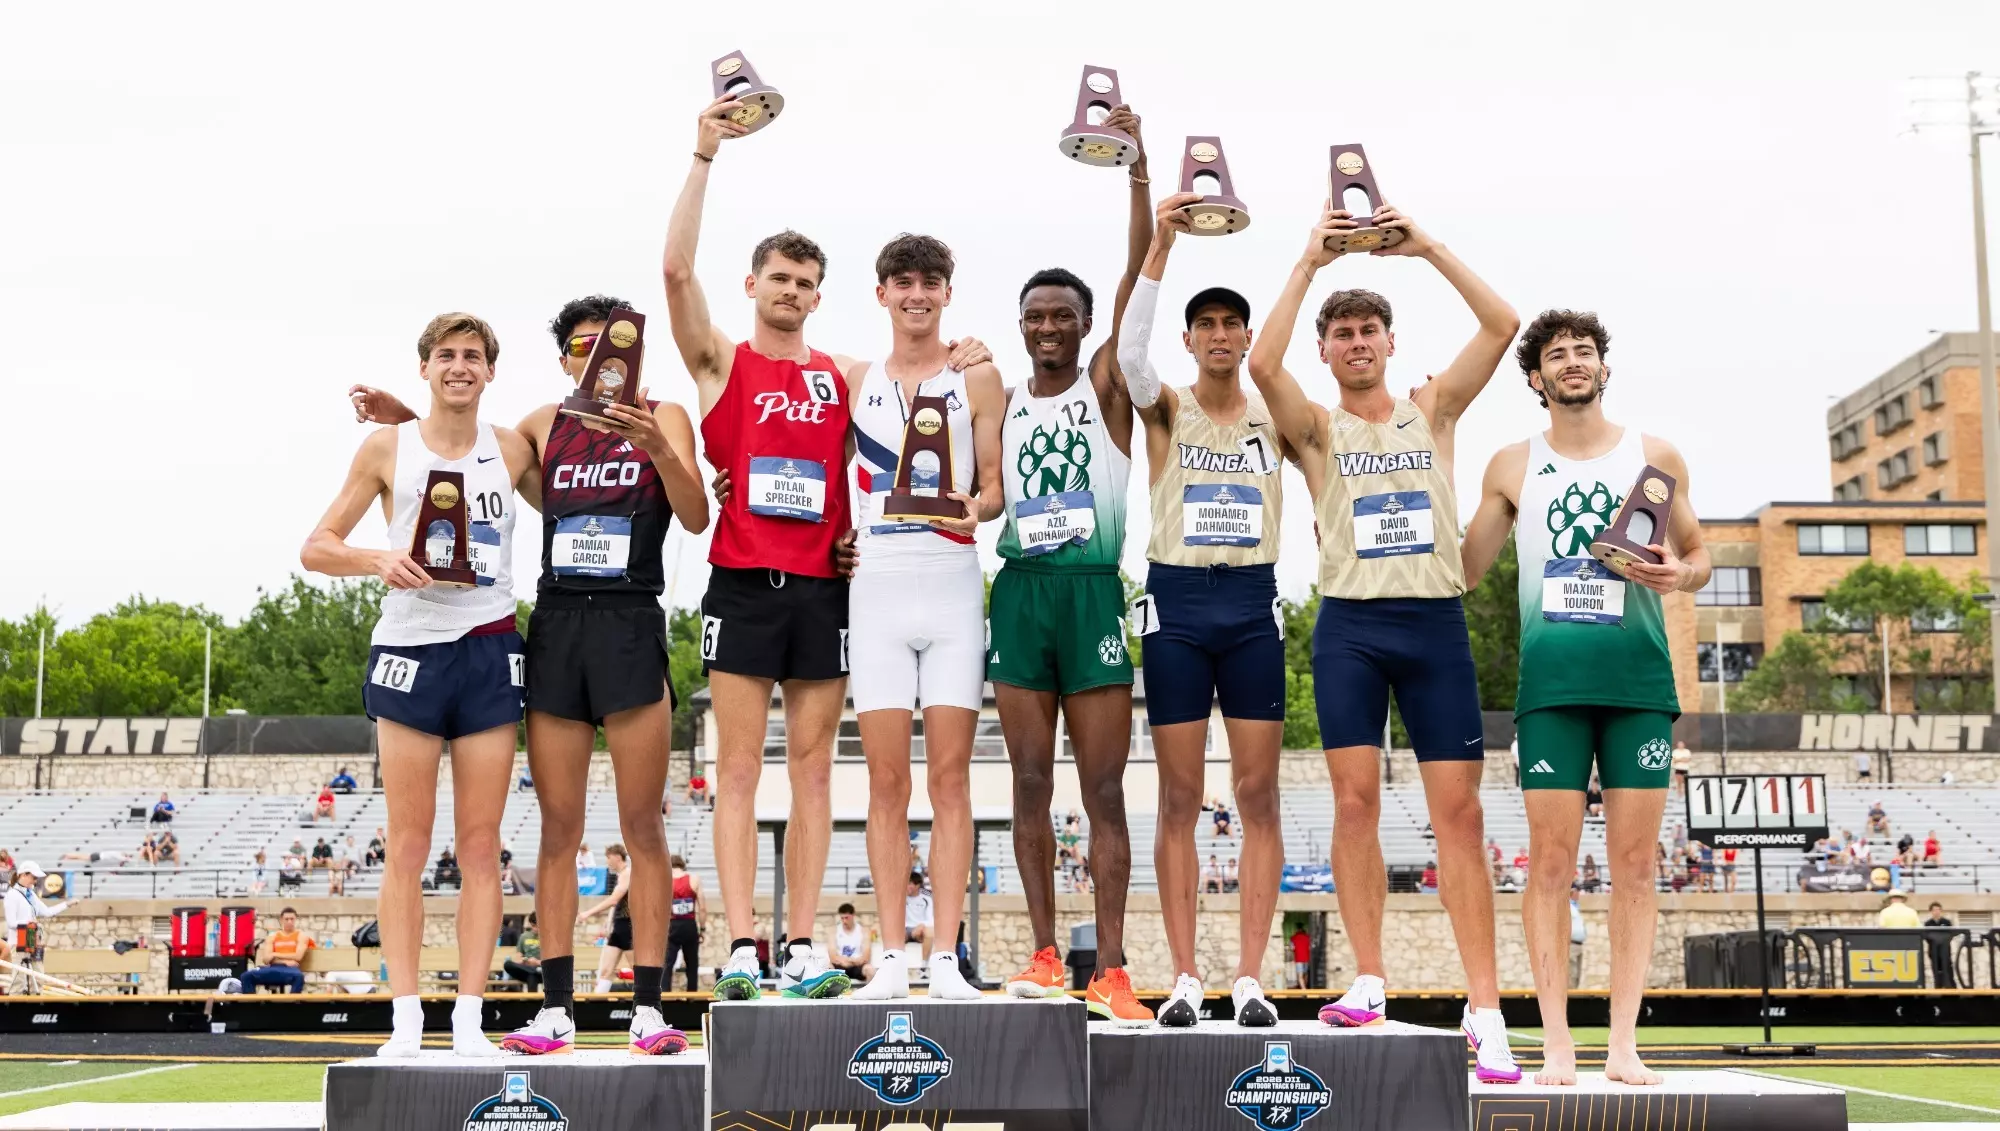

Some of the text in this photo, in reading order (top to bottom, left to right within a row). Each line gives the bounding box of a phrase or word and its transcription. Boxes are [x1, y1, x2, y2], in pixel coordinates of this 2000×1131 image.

[812, 373, 832, 402] 6
[753, 391, 826, 424] Pitt
[1060, 400, 1092, 427] 12
[917, 420, 941, 428] NCAA
[1177, 443, 1272, 475] WINGA
[1245, 436, 1268, 472] 7
[1334, 450, 1432, 476] WINGATE
[553, 461, 641, 489] CHICO
[774, 479, 805, 493] DYLAN
[765, 492, 812, 508] SPRECKER
[1645, 485, 1668, 502] NCAA
[476, 491, 503, 519] 10
[1198, 507, 1249, 520] MOHAMED
[1047, 515, 1068, 528] AZIZ
[1195, 521, 1251, 534] DAHMOUCH
[1380, 516, 1410, 530] DAVID
[572, 538, 611, 551] DAMIAN
[1375, 530, 1417, 545] HOLMAN
[572, 552, 608, 565] GARCIA
[1563, 583, 1605, 596] MAXIME
[1564, 597, 1604, 611] TOURON
[1135, 598, 1149, 635] 7
[703, 620, 715, 657] 6
[381, 658, 409, 688] 10
[515, 657, 526, 685] 1
[19, 718, 203, 755] STATE
[1798, 713, 1992, 751] HORNET
[1714, 834, 1806, 845] PERFORMANCE
[184, 968, 232, 978] BODYARMOR
[1848, 949, 1920, 983] ESU
[32, 1013, 58, 1024] GILL
[322, 1013, 348, 1023] GILL
[868, 1052, 892, 1060] OUTDOOR
[893, 1052, 910, 1060] TRACK
[916, 1052, 932, 1060] FIELD
[850, 1060, 949, 1074] CHAMPIONSHIPS
[1246, 1082, 1271, 1090] OUTDOOR
[1272, 1082, 1289, 1090] TRACK
[1295, 1082, 1311, 1090] FIELD
[1229, 1090, 1328, 1104] CHAMPIONSHIPS
[483, 1112, 509, 1120] OUTDOOR
[509, 1112, 527, 1120] TRACK
[532, 1112, 548, 1120] FIELD
[493, 1105, 539, 1113] 2026 DII
[466, 1120, 565, 1131] CHAMPIONSHIPS
